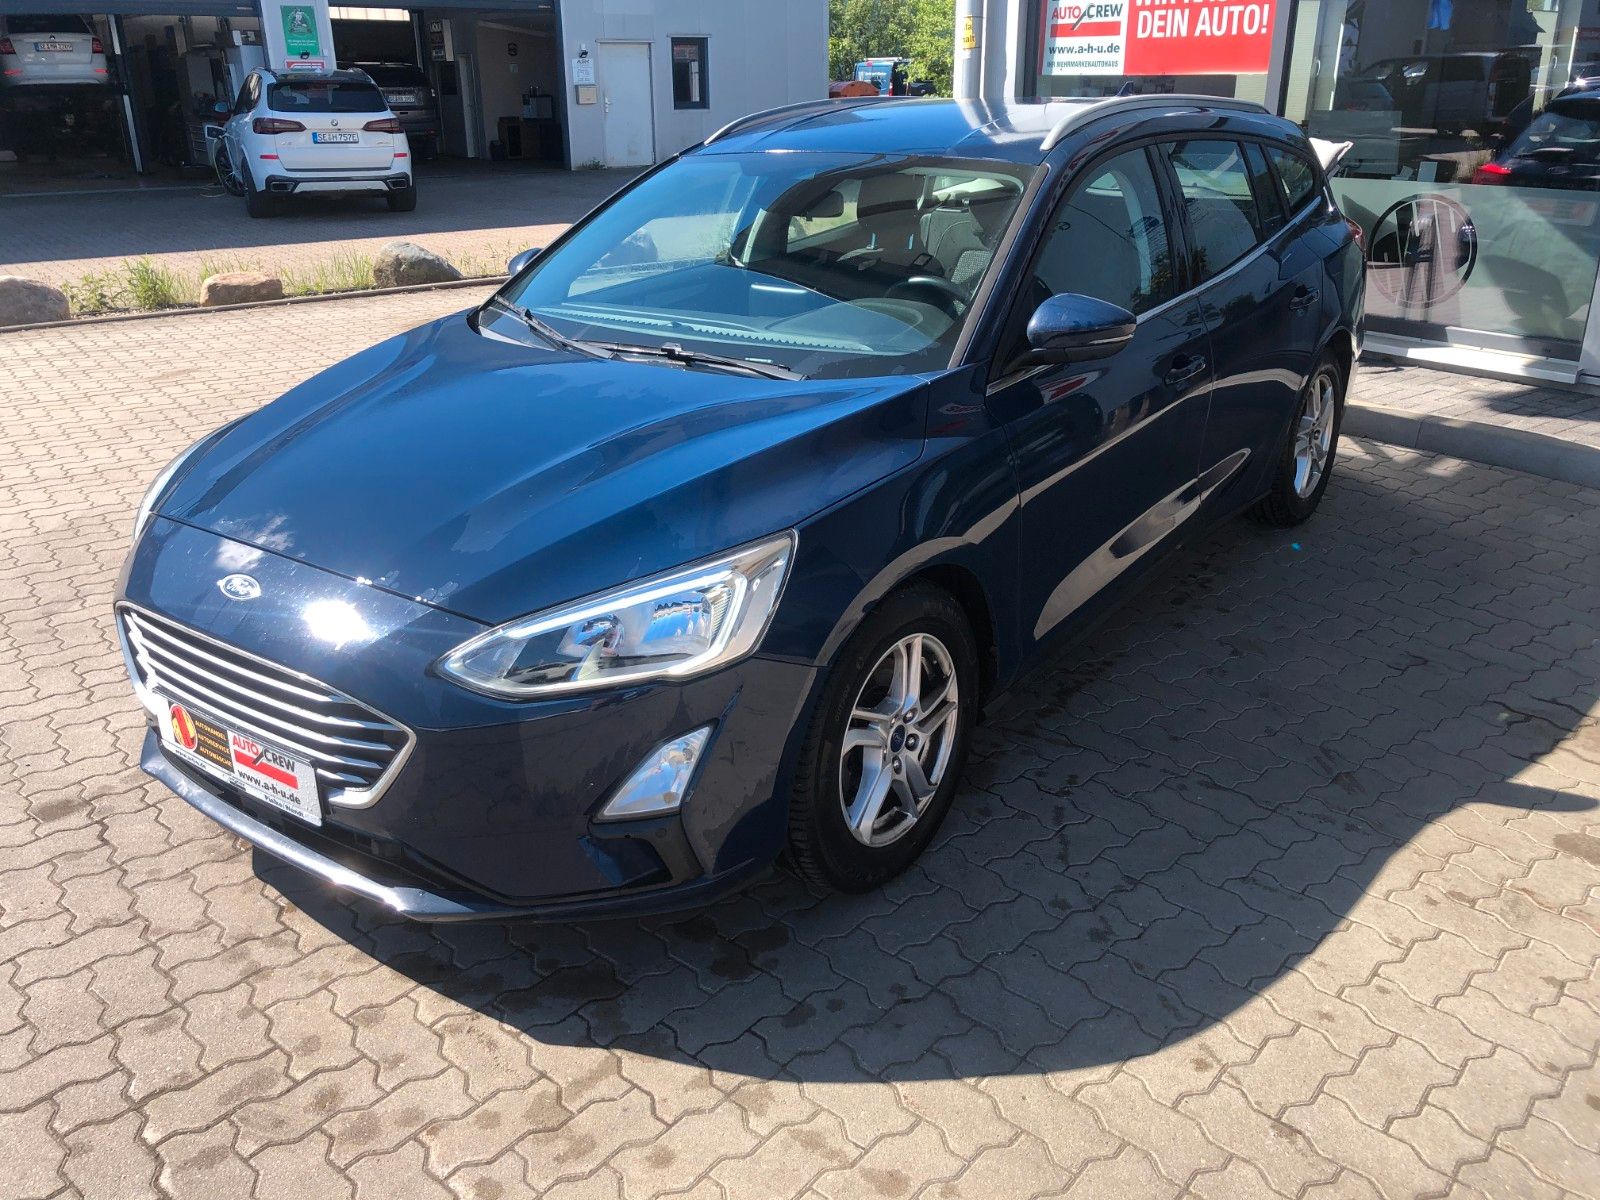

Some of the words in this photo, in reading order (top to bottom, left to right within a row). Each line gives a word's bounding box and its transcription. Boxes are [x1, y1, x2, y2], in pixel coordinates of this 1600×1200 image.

[1051, 5, 1082, 20] AUTO
[1087, 3, 1123, 19] CREW
[1136, 8, 1190, 39] DEIN
[1194, 3, 1270, 37] AUTO!
[1048, 42, 1121, 55] www.a-h-u.de
[232, 734, 259, 756] AUTO
[263, 748, 295, 772] CREW
[237, 769, 301, 805] www.a-h-u.de
